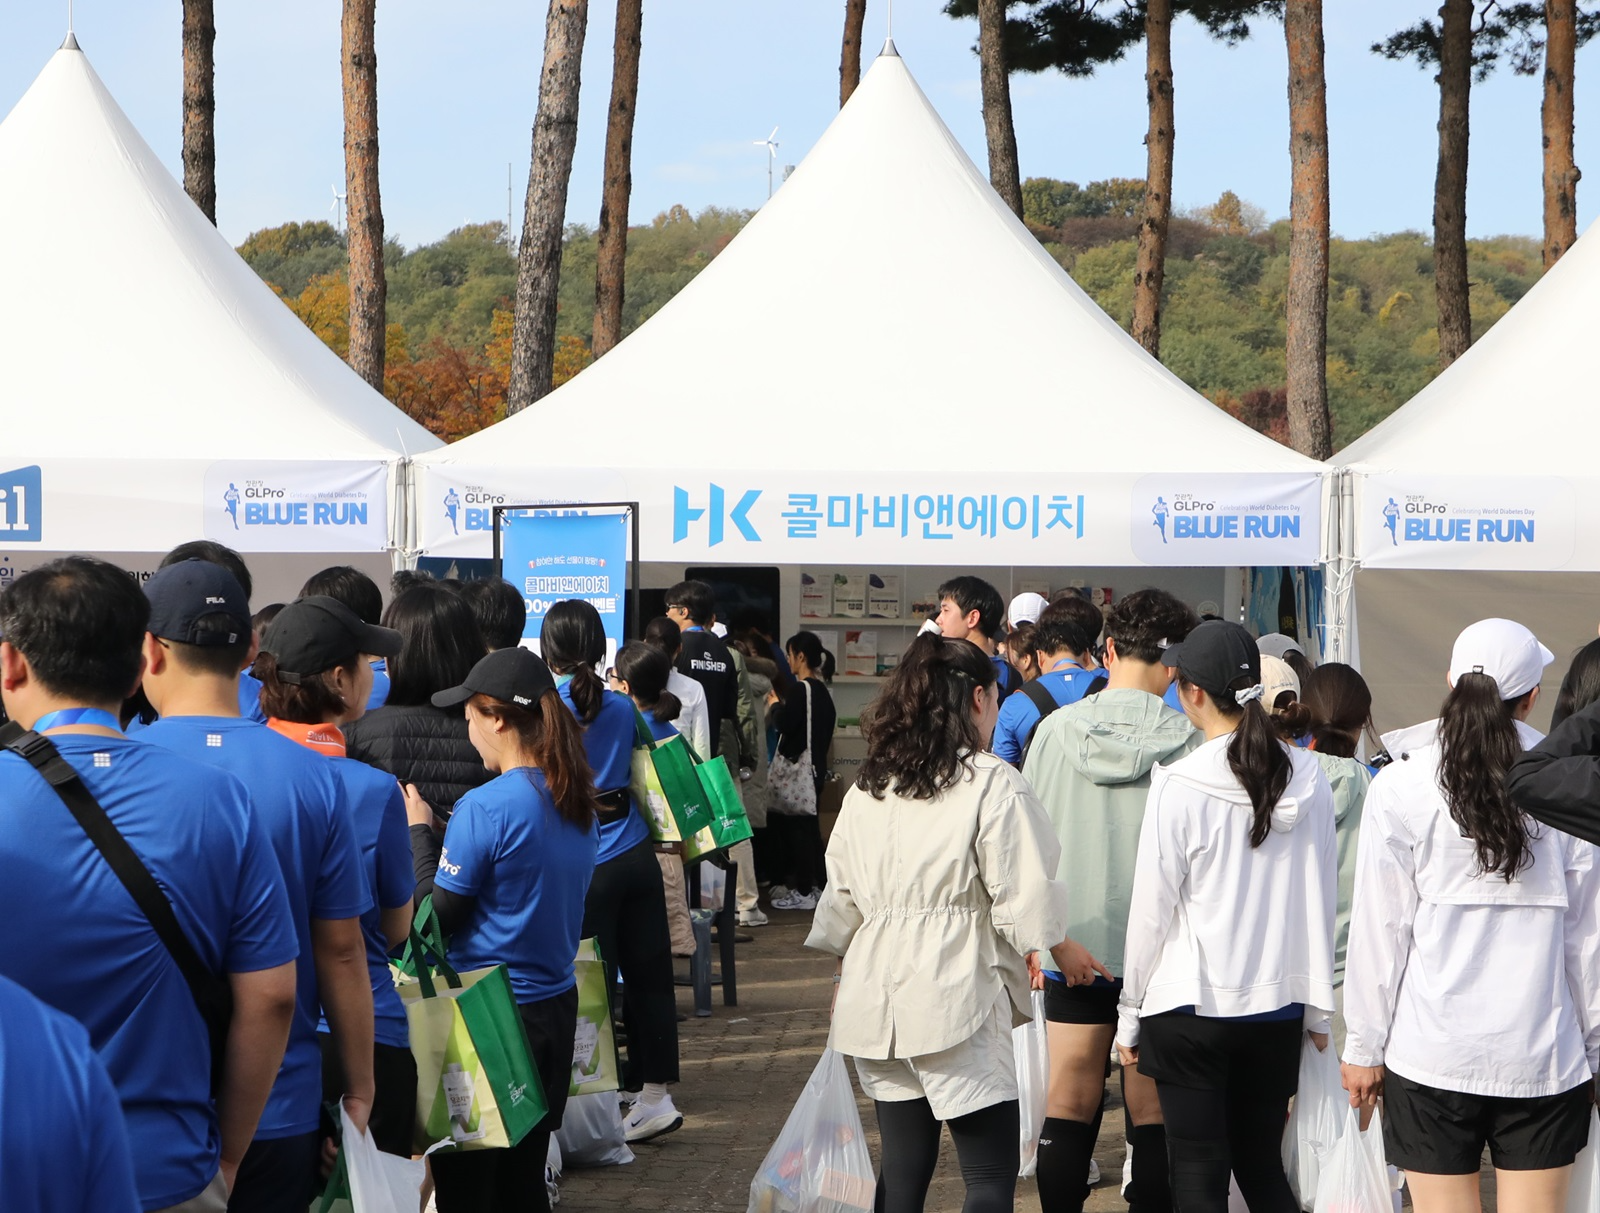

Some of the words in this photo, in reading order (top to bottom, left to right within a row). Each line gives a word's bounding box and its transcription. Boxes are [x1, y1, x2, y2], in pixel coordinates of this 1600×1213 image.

[358, 492, 367, 500] Day
[245, 502, 307, 525] BLUE
[313, 502, 367, 525] RUN
[673, 482, 763, 548] HK
[781, 493, 1084, 540] 콜마비앤에이치
[1220, 504, 1248, 512] Celebrating
[1290, 504, 1300, 512] Day
[1452, 507, 1481, 516] Celebrating
[1174, 515, 1238, 538] BLUE
[1244, 515, 1300, 538] RUN
[1404, 518, 1471, 542] BLUE
[1476, 519, 1535, 543] RUN
[525, 576, 609, 594] 콜마비앤에이치
[691, 659, 726, 672] FINISHER
